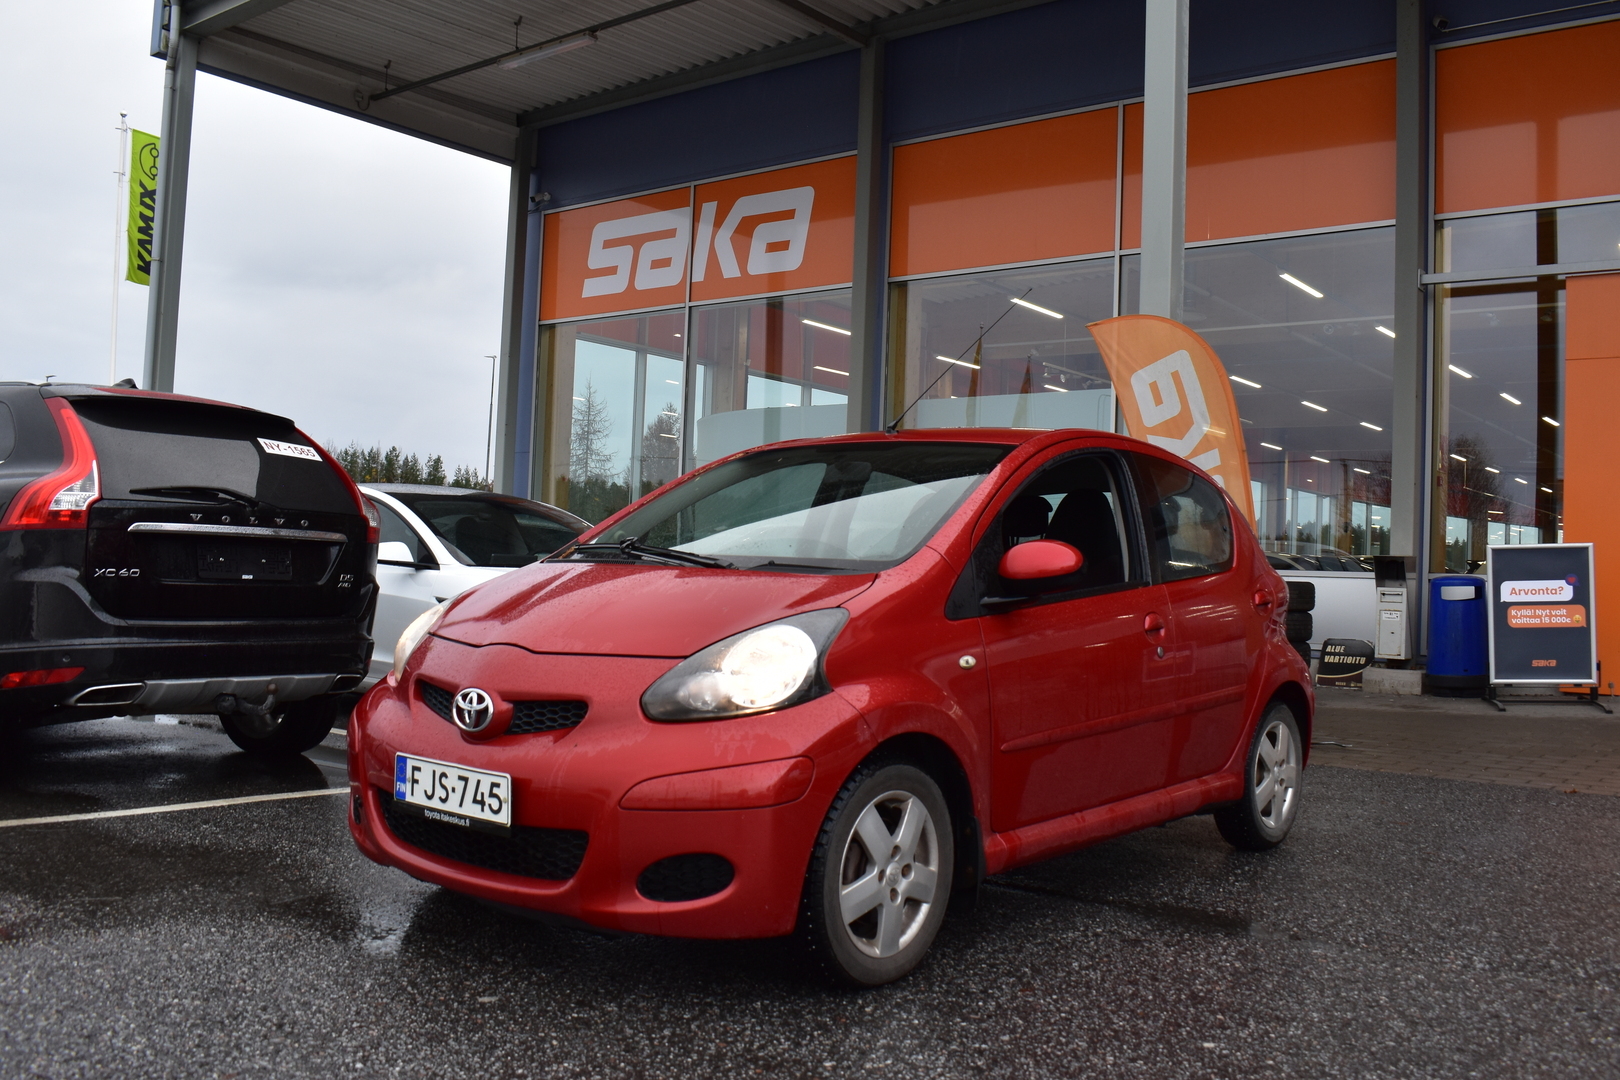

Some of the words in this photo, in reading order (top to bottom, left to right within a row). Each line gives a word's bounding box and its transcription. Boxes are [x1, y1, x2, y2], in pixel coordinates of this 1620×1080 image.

[190, 513, 309, 527] VOLVO
[1509, 586, 1564, 596] Arvonta?
[1511, 609, 1534, 617] Kyllä!
[1535, 609, 1550, 617] Nyt
[1325, 645, 1346, 653] ALUE
[1324, 655, 1366, 665] VARTIOITU
[396, 781, 406, 793] FIN
[411, 765, 503, 815] FJS-745
